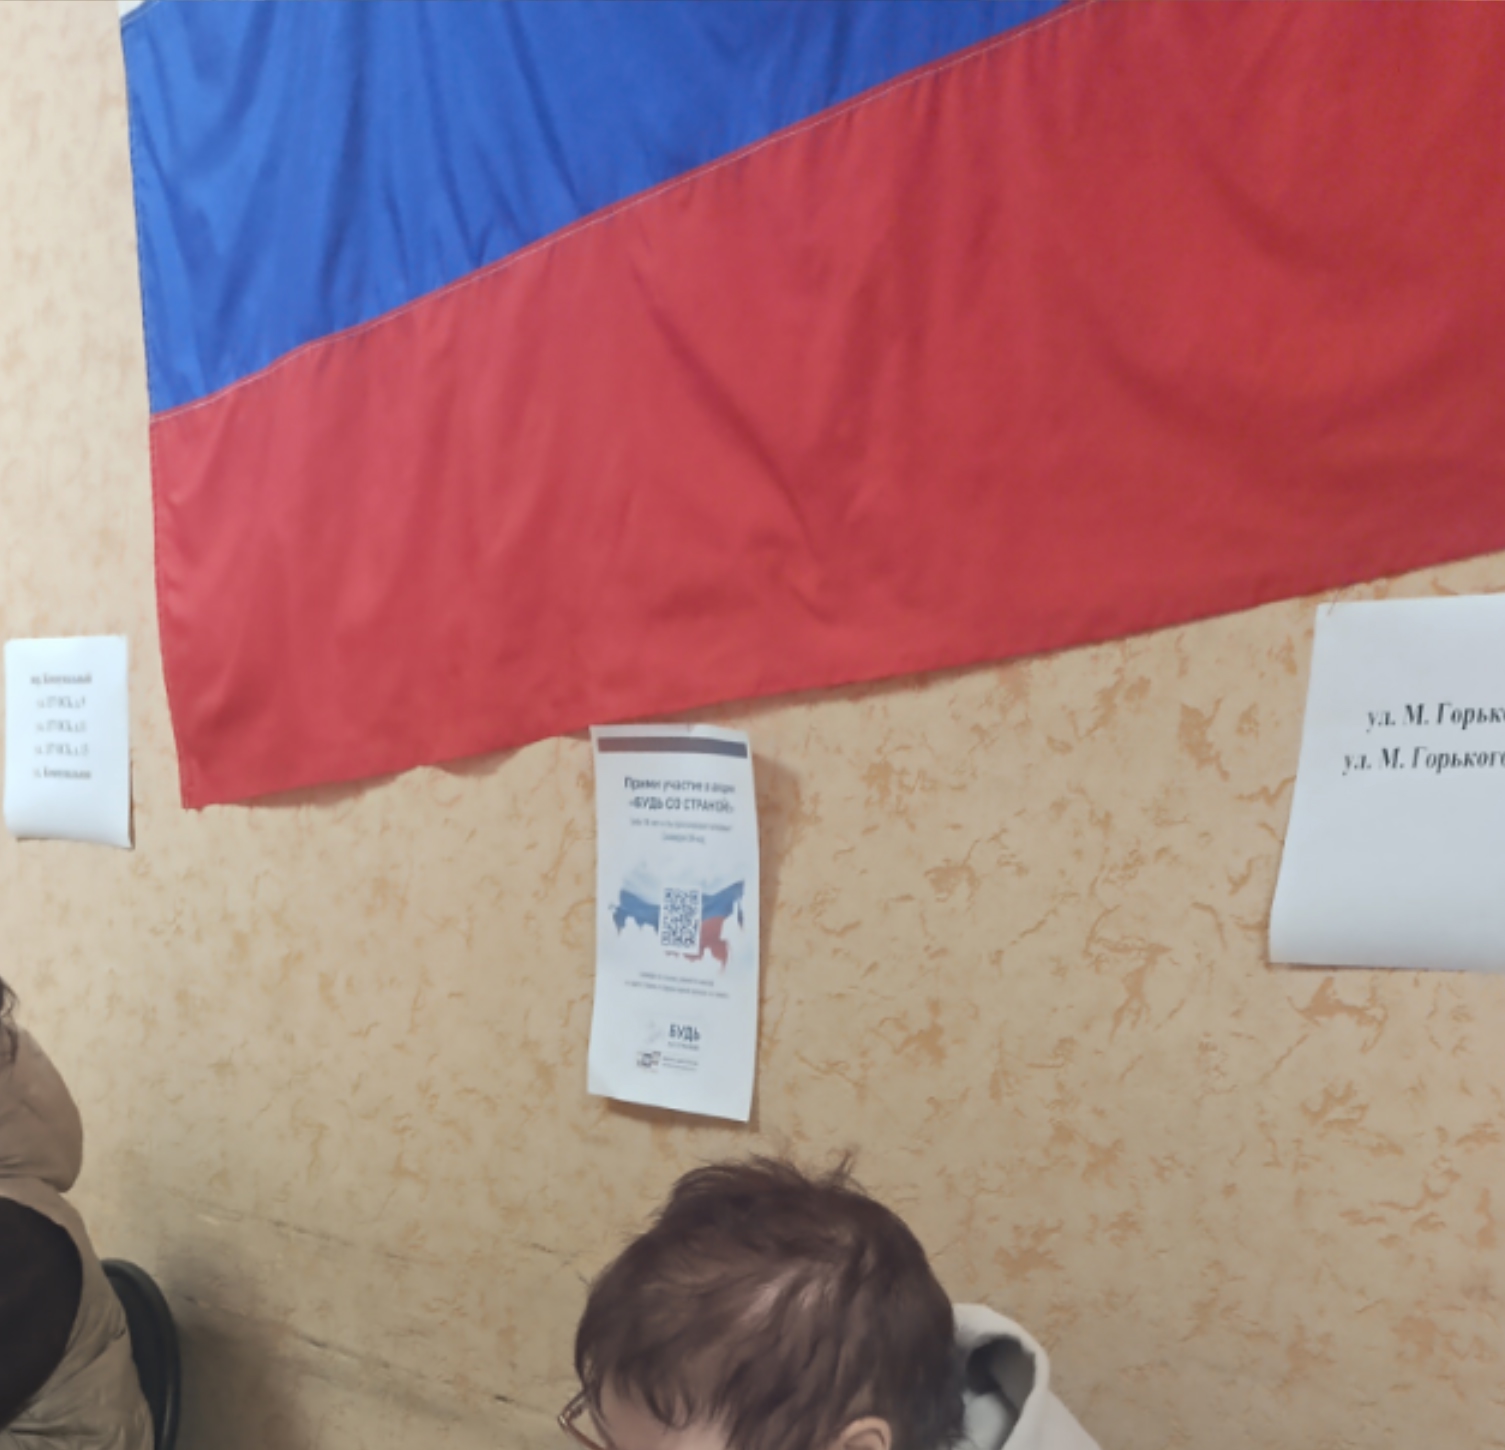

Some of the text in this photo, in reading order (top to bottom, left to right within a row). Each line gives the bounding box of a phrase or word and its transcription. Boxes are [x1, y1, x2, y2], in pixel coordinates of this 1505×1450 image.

[1365, 702, 1505, 733] ул. М. Горьк
[1342, 755, 1372, 776] ул.
[1379, 747, 1404, 769] М.
[669, 1023, 701, 1042] БУДЬ
